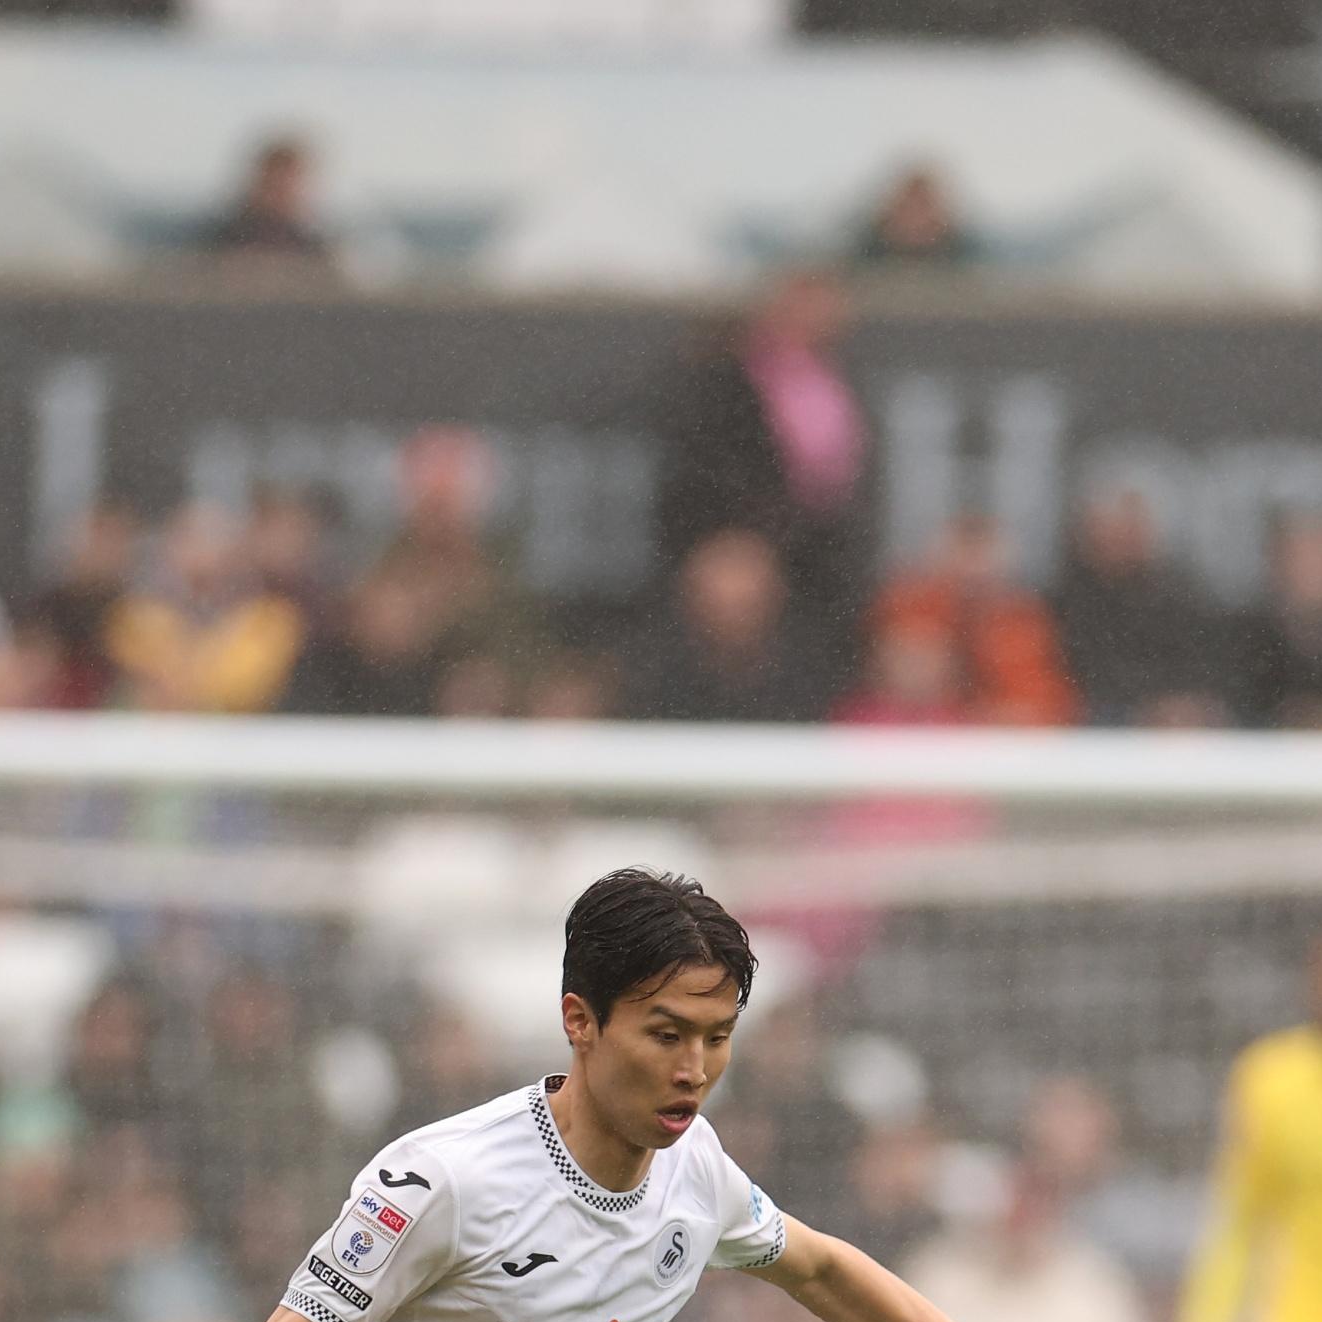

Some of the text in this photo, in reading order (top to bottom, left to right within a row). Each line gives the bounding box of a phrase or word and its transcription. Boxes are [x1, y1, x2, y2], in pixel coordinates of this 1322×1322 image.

[361, 1196, 404, 1230] sky bet
[342, 1250, 359, 1268] EFL
